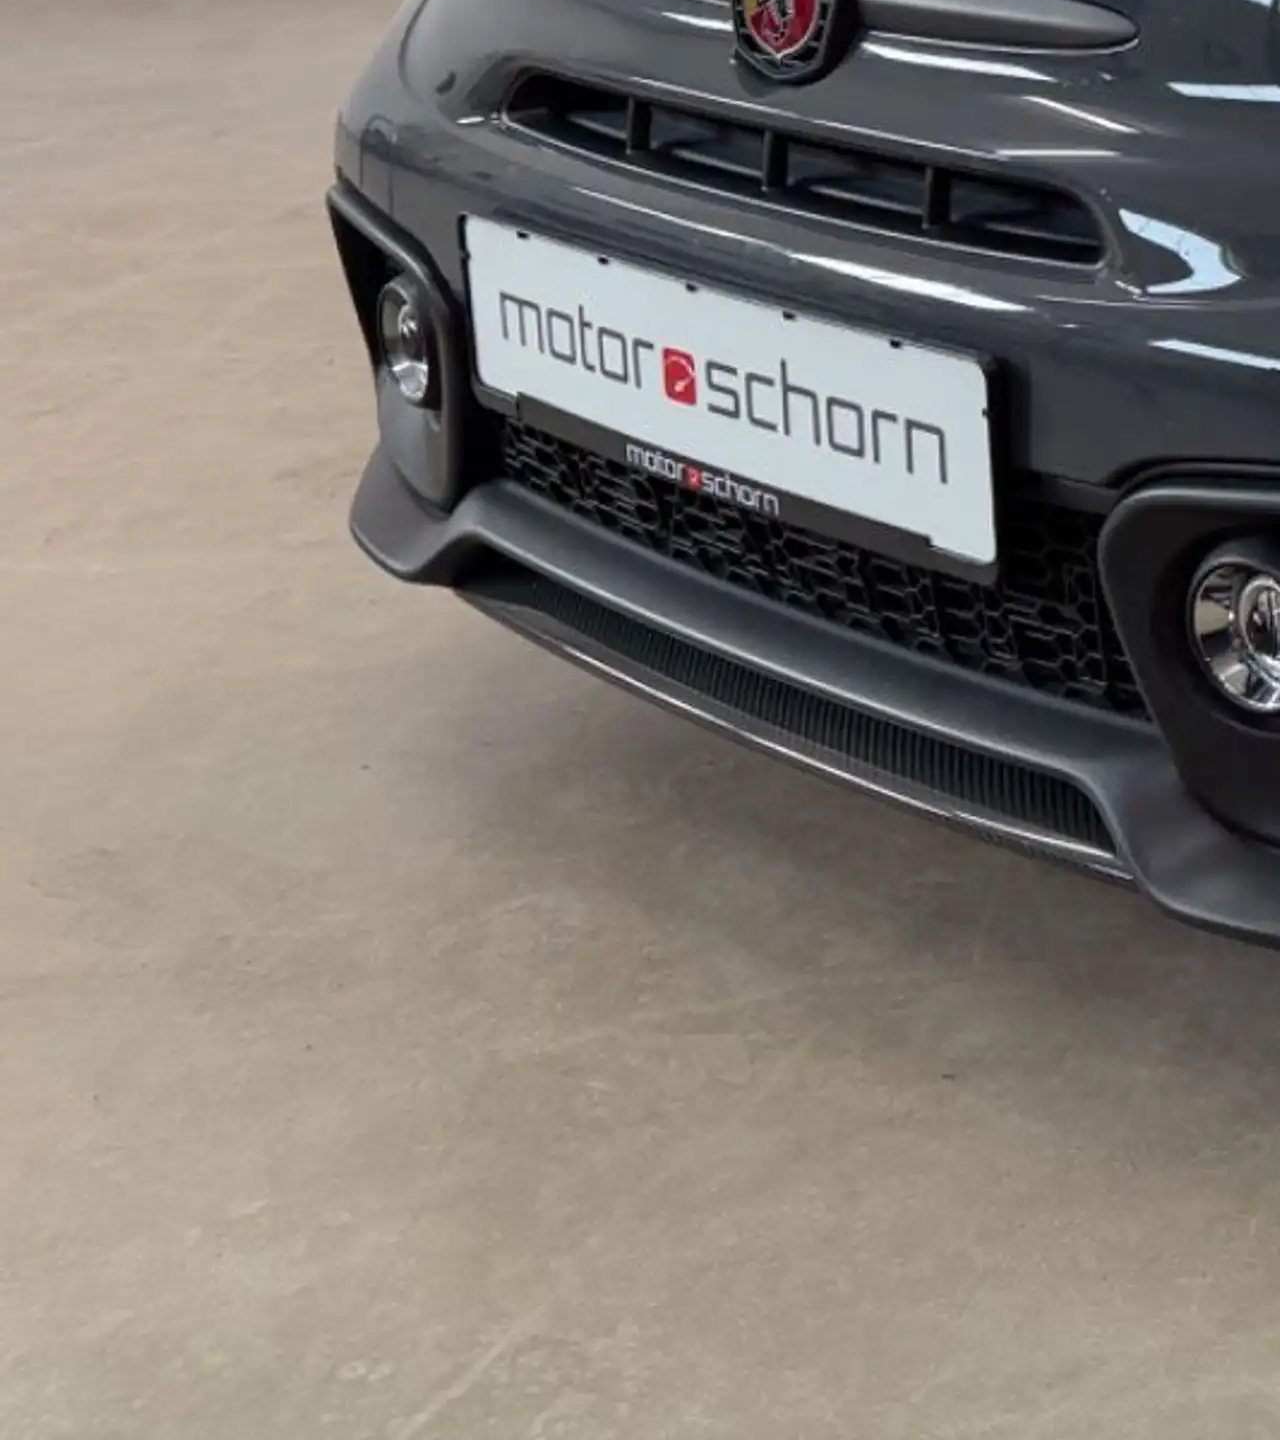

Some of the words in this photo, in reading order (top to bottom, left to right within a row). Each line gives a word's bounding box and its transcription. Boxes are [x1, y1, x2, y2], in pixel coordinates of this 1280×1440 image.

[499, 291, 655, 389] motor
[705, 358, 948, 484] schorn
[626, 443, 686, 482] motor
[701, 471, 780, 517] schorn
